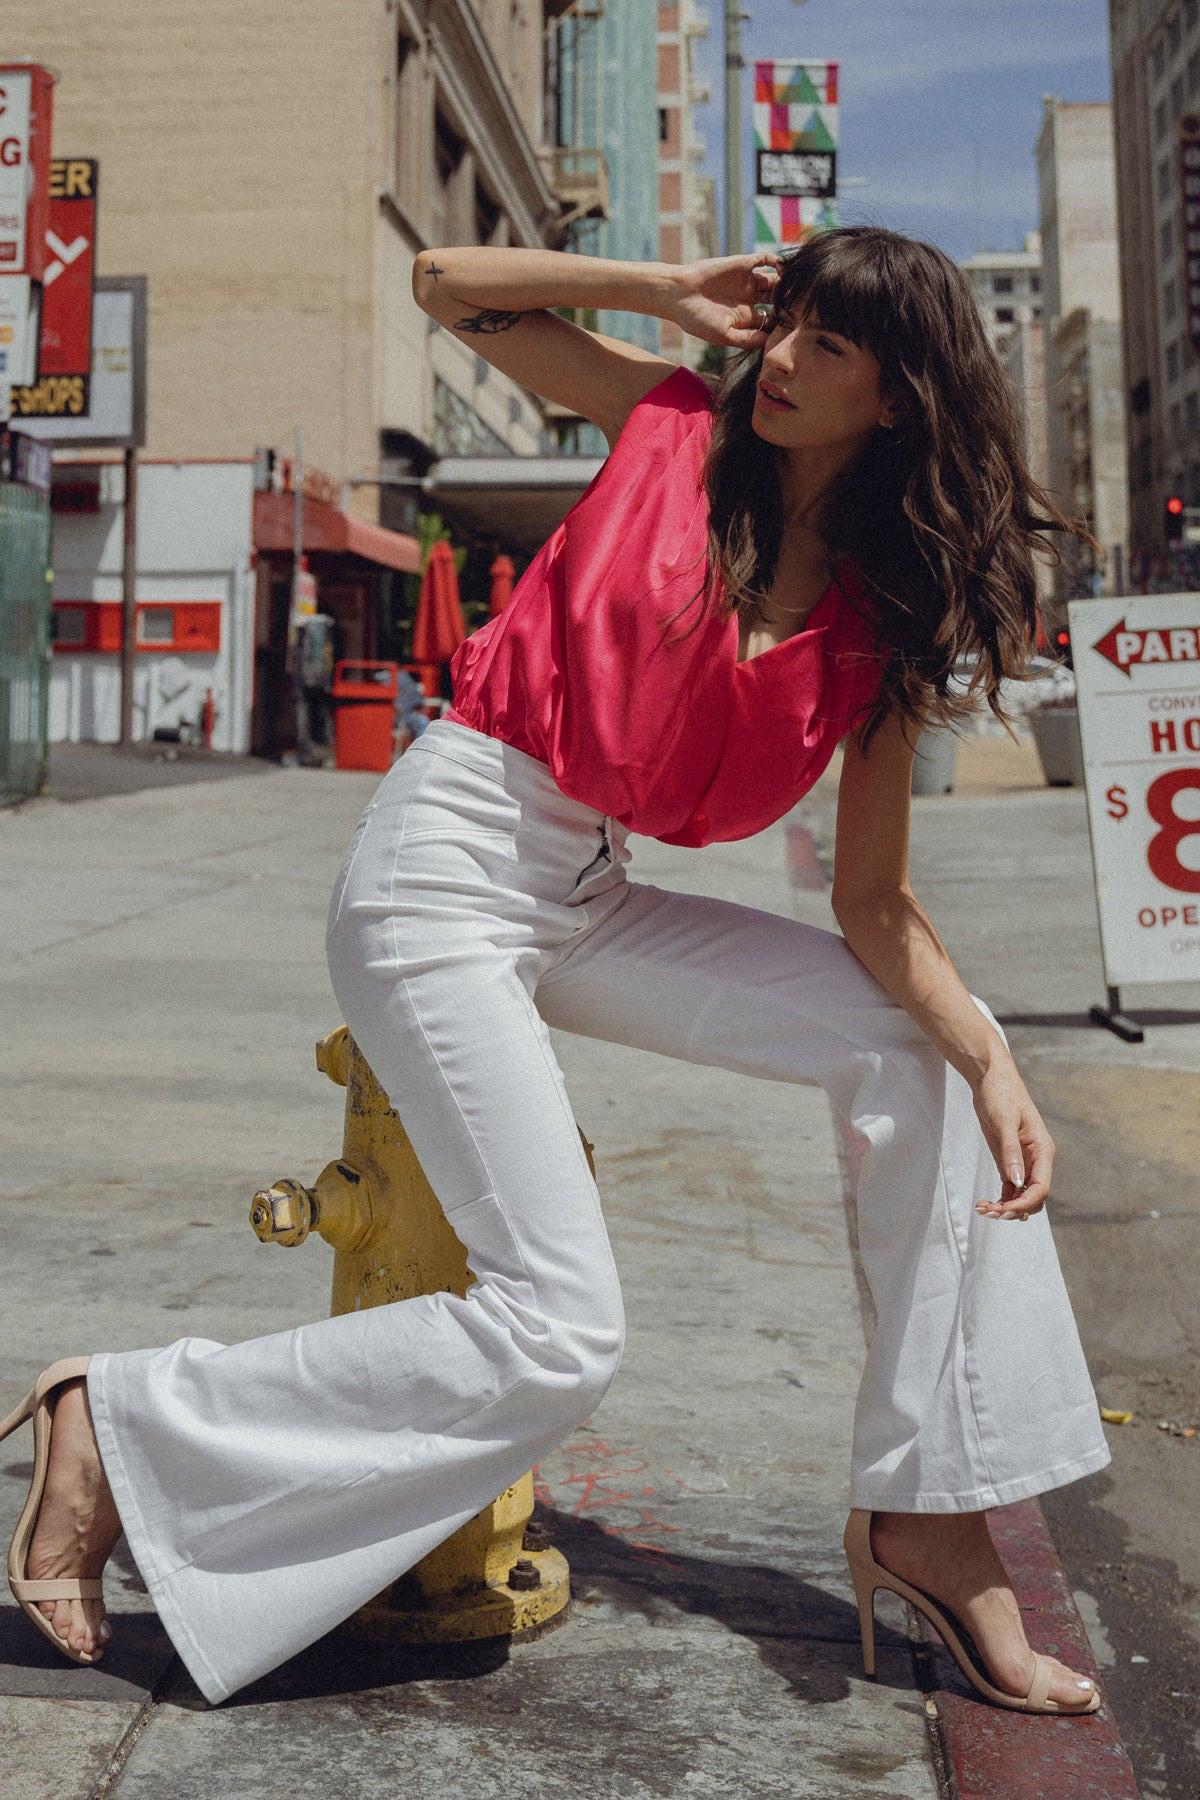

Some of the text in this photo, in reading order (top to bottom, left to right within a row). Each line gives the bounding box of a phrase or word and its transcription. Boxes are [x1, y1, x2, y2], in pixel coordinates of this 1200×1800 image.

[1116, 629, 1200, 664] PAR
[1148, 696, 1200, 711] CONV
[1138, 904, 1199, 928] OPE
